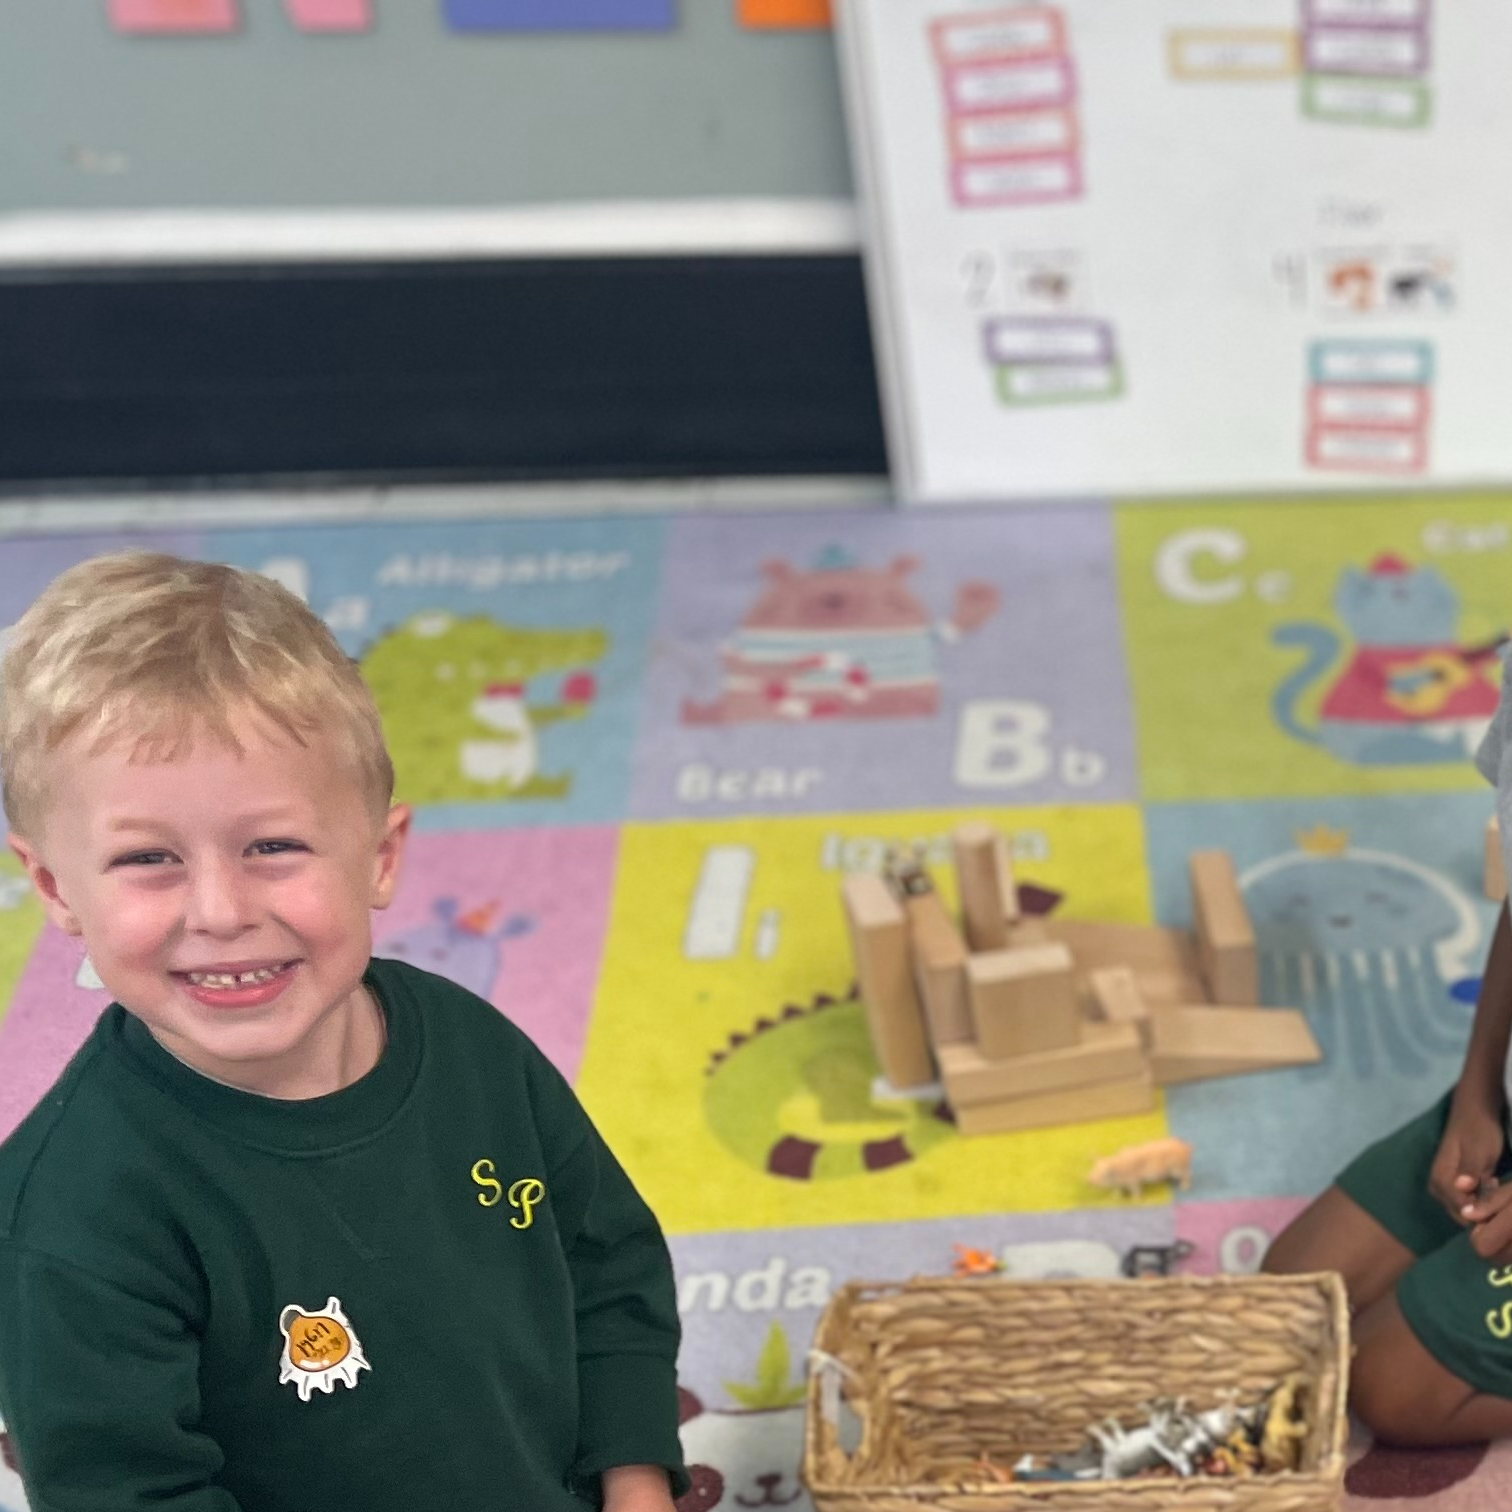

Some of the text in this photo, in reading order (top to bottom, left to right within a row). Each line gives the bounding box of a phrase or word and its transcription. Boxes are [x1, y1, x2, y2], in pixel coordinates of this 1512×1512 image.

[377, 551, 632, 591] Alligator
[1153, 528, 1247, 602] C
[954, 702, 1104, 788] B b
[678, 764, 823, 802] Bear
[678, 1257, 831, 1313] nda
